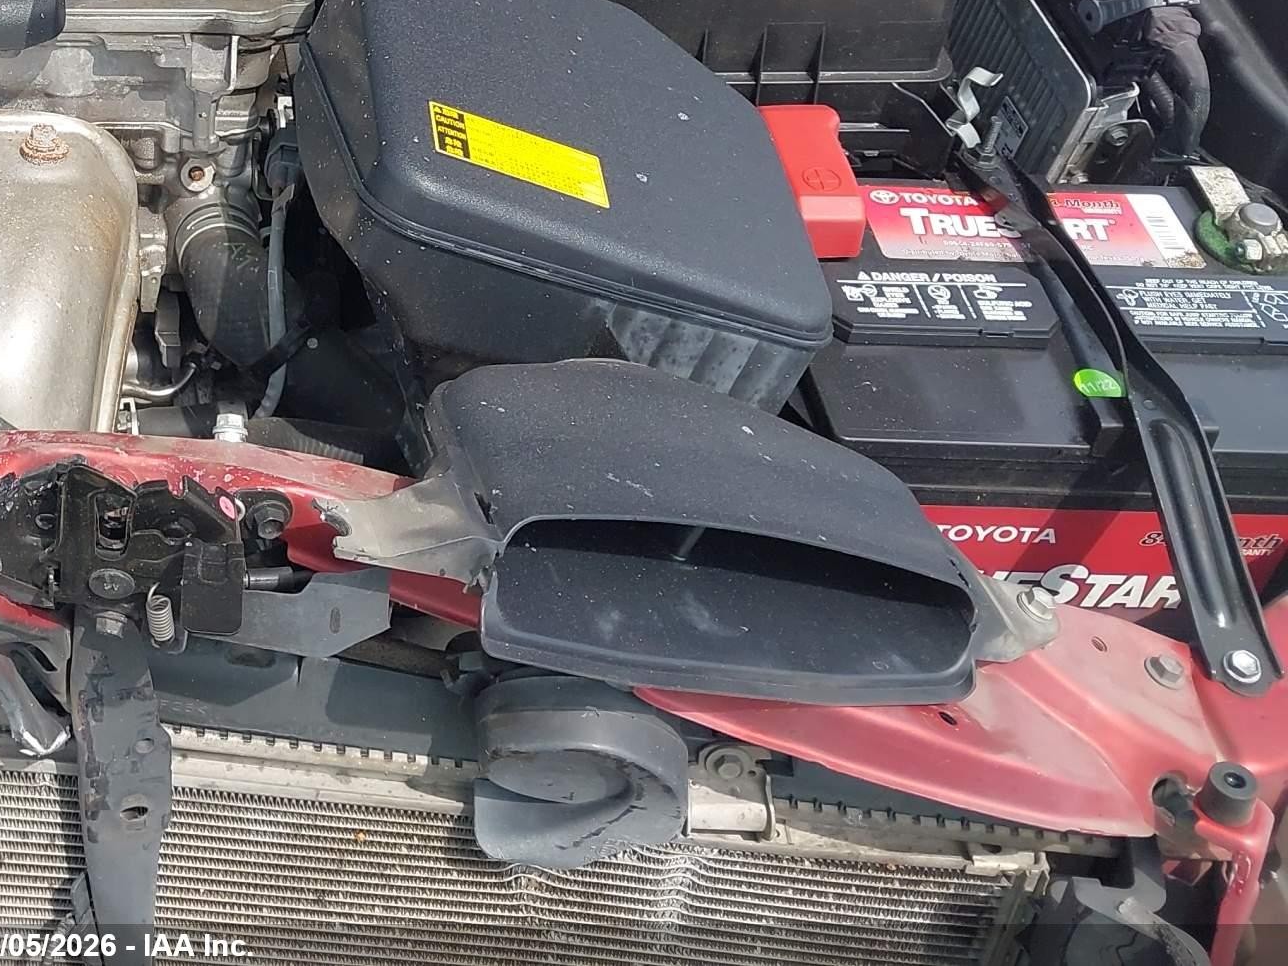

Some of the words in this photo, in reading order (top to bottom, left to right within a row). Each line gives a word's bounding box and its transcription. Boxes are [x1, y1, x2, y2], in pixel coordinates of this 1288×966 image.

[899, 192, 979, 207] TOYOTA
[871, 271, 932, 283] DANGER
[941, 273, 998, 283] POISON
[937, 525, 1057, 544] TOYOTA
